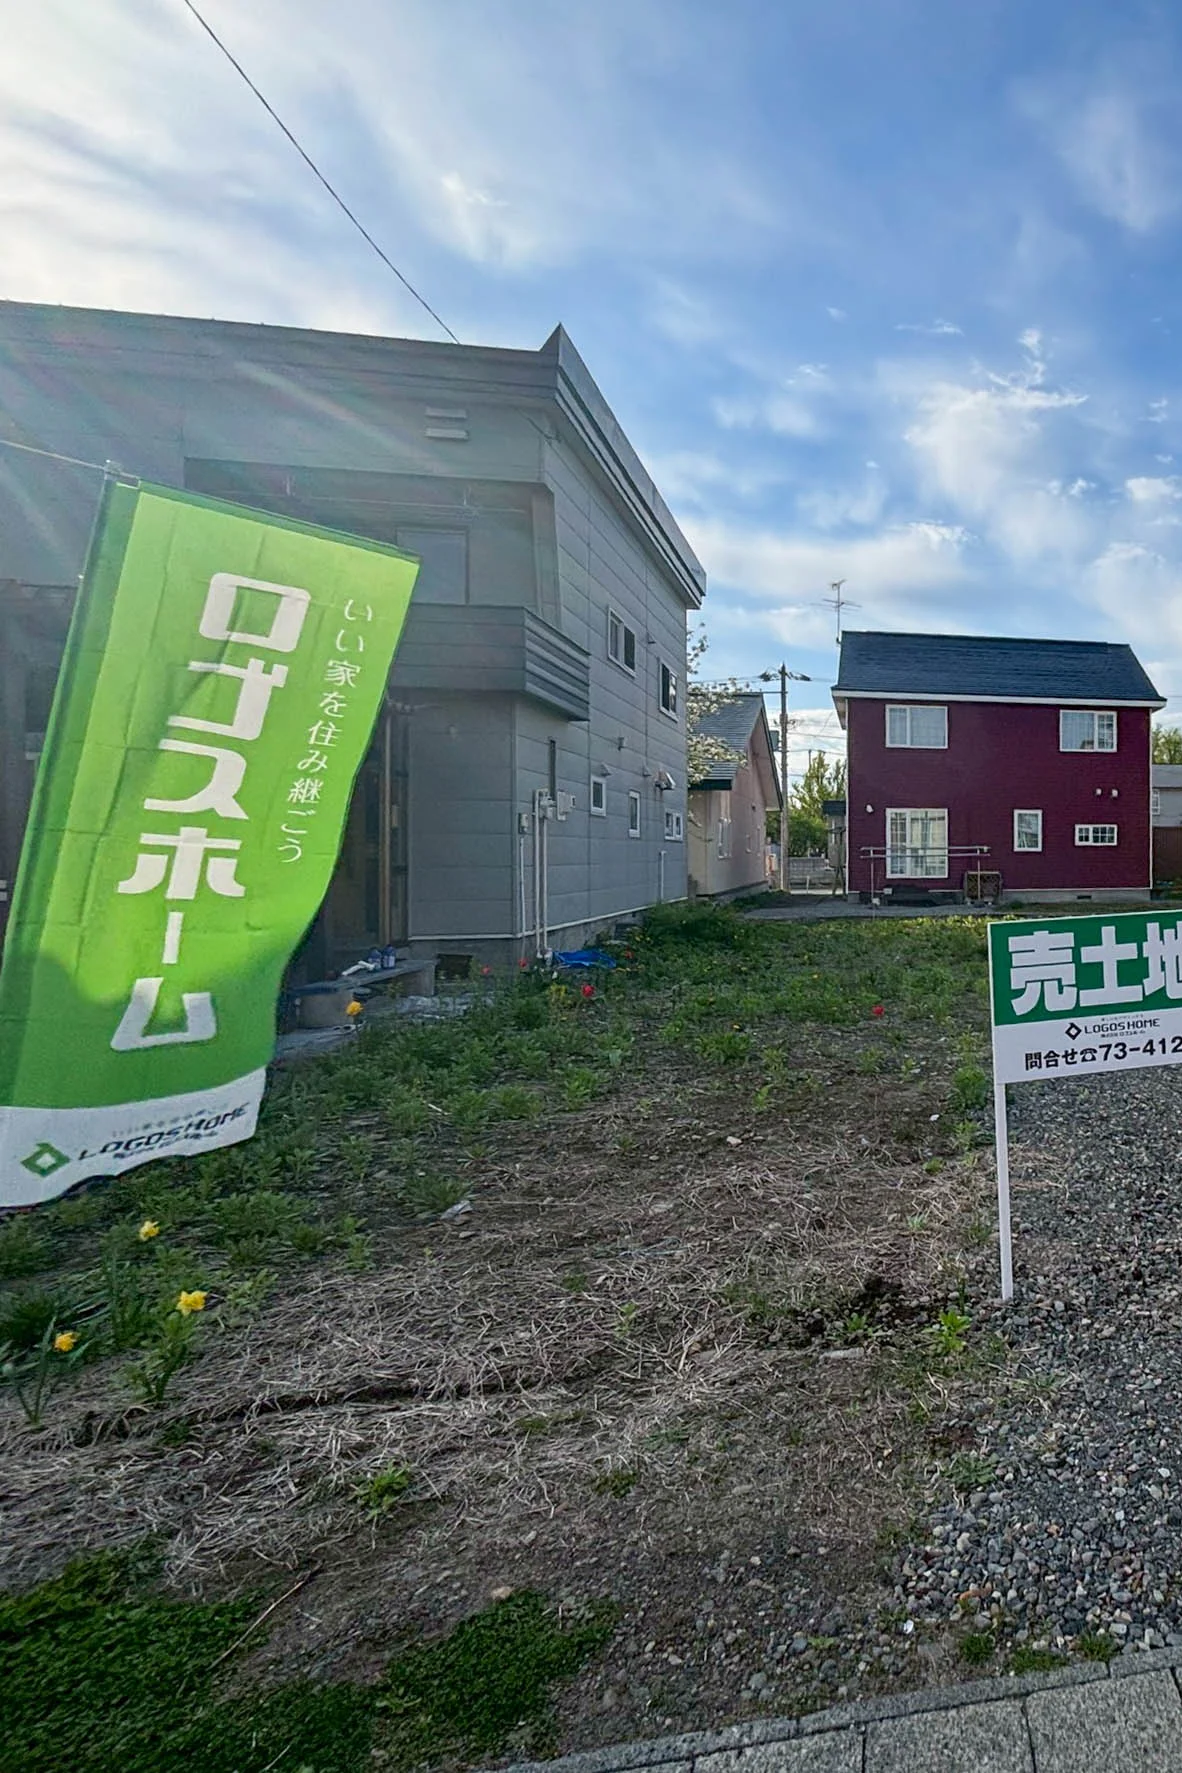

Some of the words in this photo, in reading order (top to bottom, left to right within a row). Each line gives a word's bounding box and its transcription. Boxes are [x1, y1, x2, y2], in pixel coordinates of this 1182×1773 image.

[110, 572, 311, 1052] ロゴスホーム
[277, 599, 373, 863] いい家を住み継ごう
